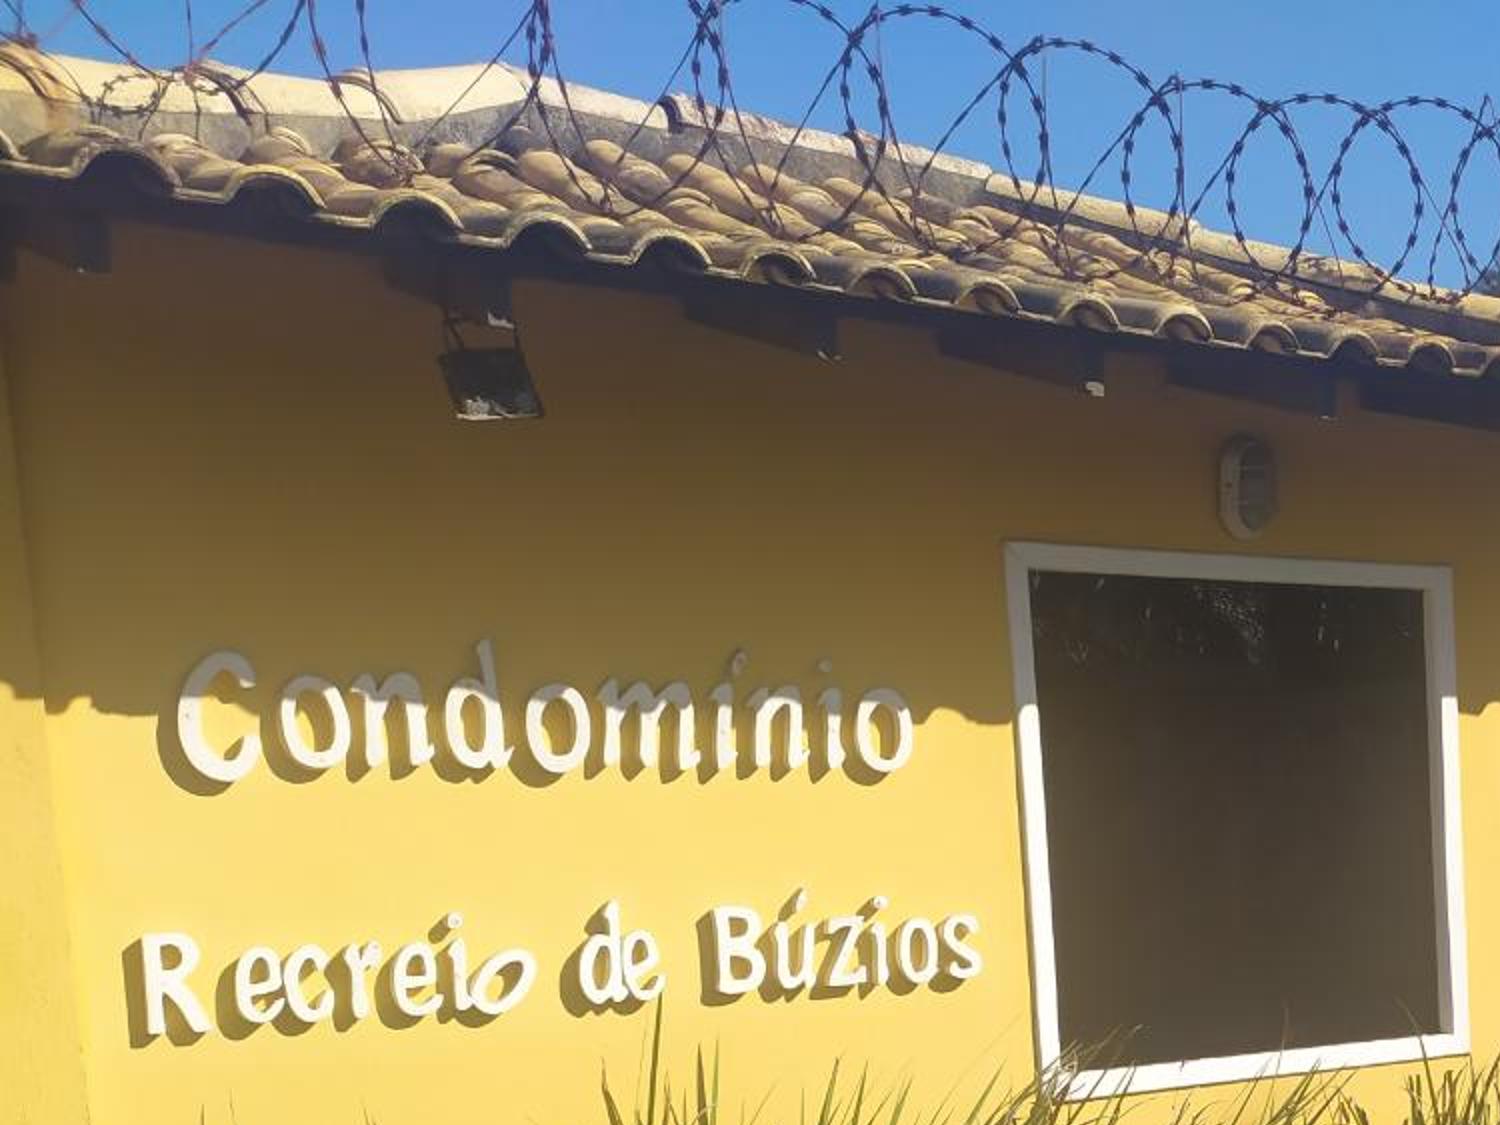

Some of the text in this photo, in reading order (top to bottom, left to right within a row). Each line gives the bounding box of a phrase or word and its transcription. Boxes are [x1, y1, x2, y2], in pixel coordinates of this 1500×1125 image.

[176, 638, 914, 783] Condomínio
[143, 889, 983, 1036] Recreio de Búzios
